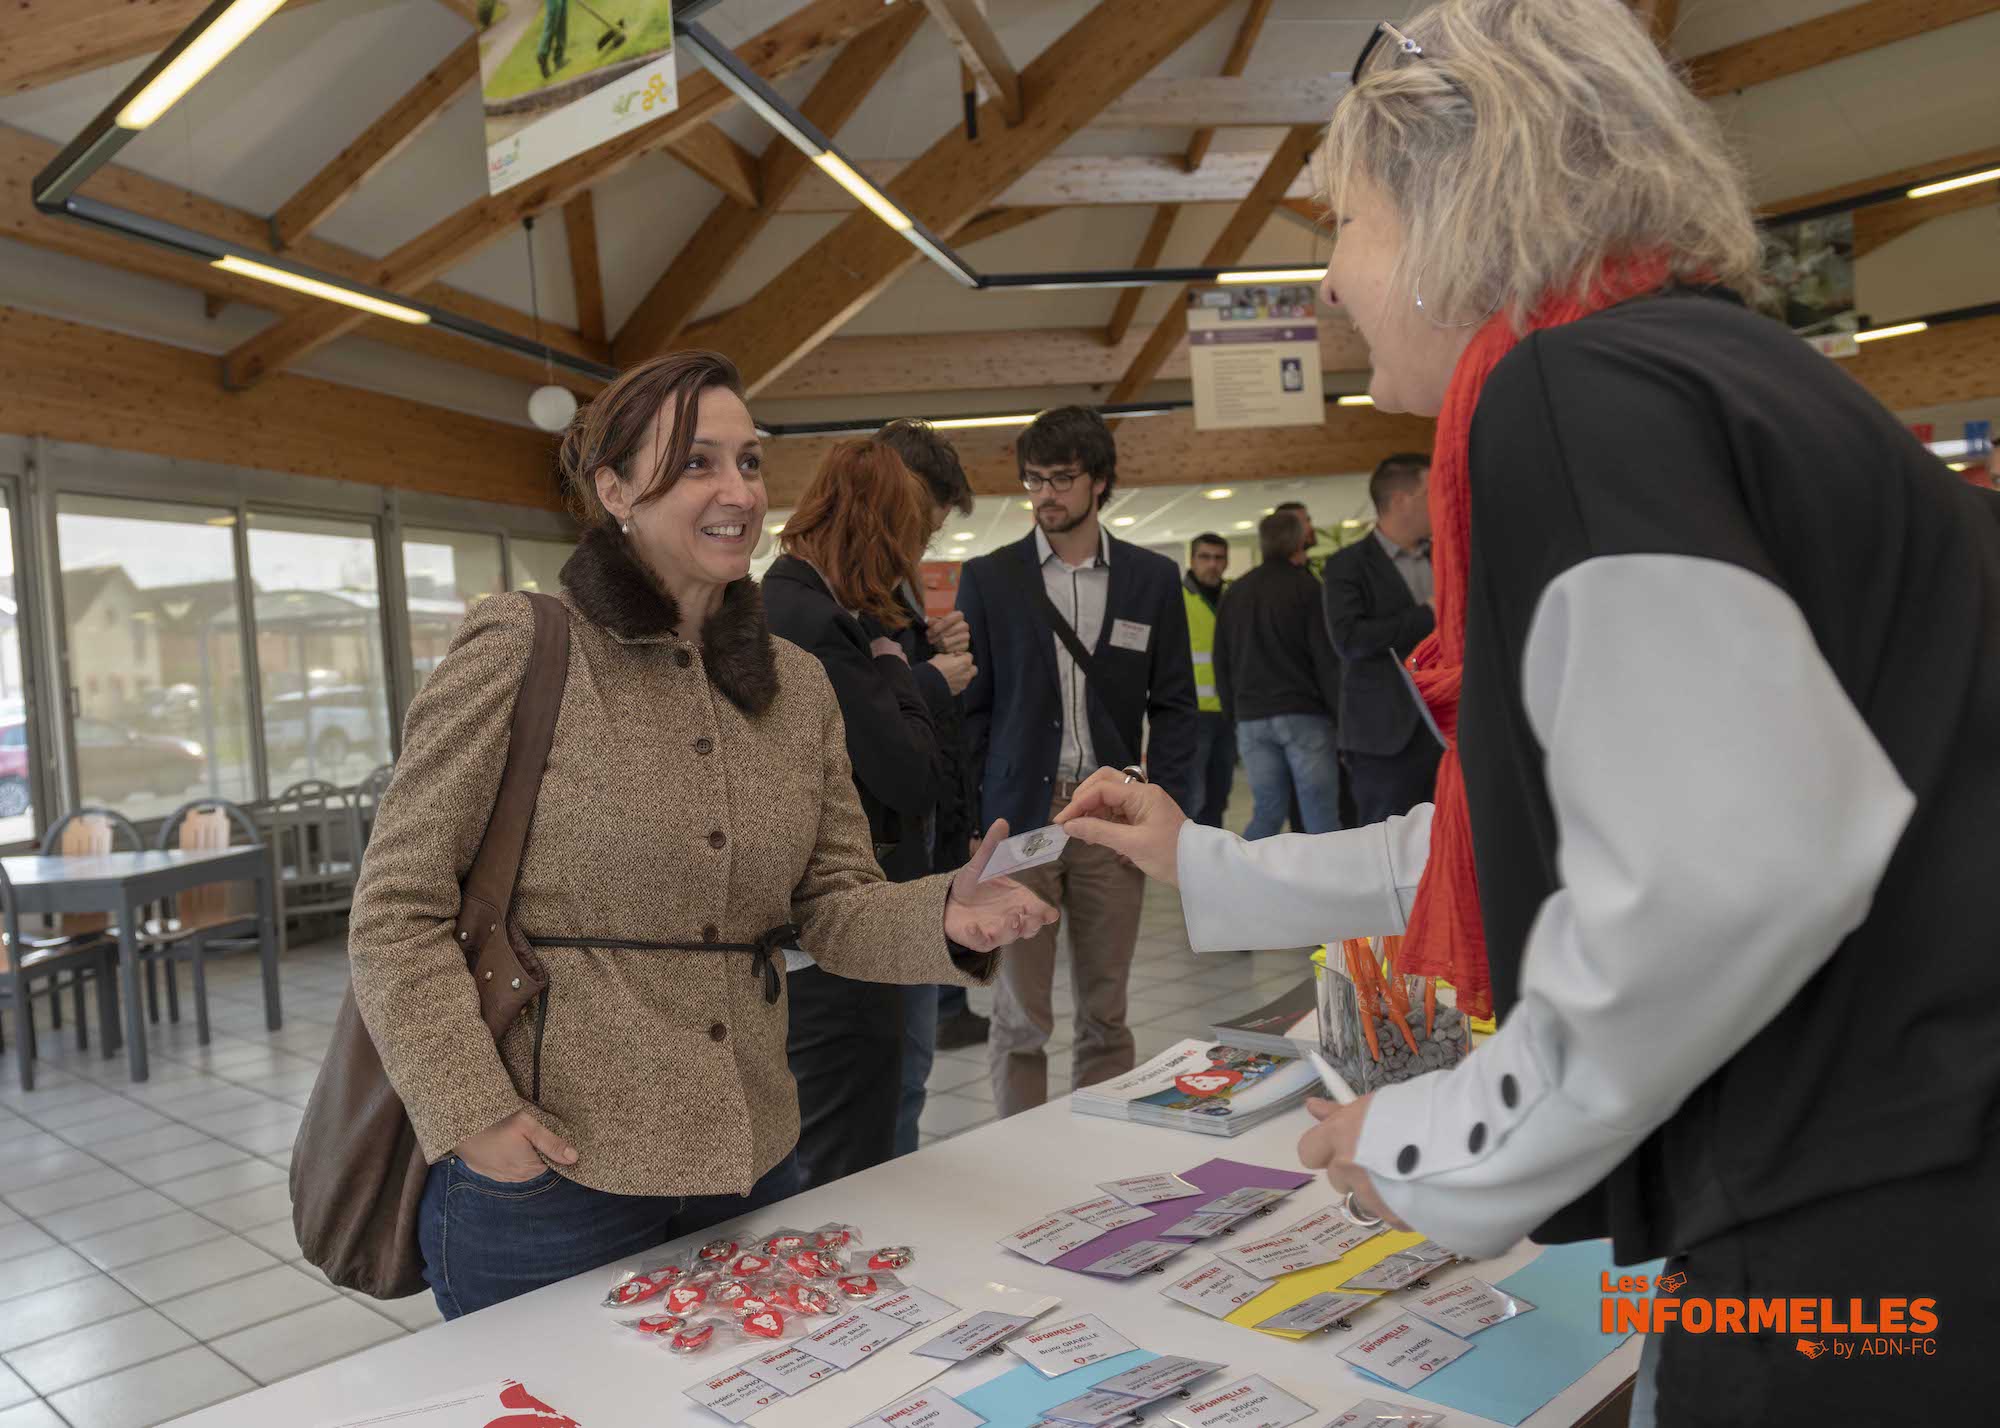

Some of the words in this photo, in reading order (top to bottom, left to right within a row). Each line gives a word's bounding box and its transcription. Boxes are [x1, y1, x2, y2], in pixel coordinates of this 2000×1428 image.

[1181, 1266, 1221, 1291] INFORMELLES
[813, 1314, 860, 1342] INFORMELLES
[1028, 1322, 1087, 1344] INFORMELLES
[1362, 1323, 1409, 1354] INFORMELLES
[1039, 1345, 1061, 1355] Bruno
[1062, 1332, 1101, 1347] GRAVELLE
[707, 1392, 735, 1408] Frédéric
[1191, 1385, 1252, 1414] INFORMELLES
[1201, 1412, 1230, 1427] Romain
[1230, 1395, 1269, 1413] SOUCHON
[912, 1410, 940, 1426] GIRARD
